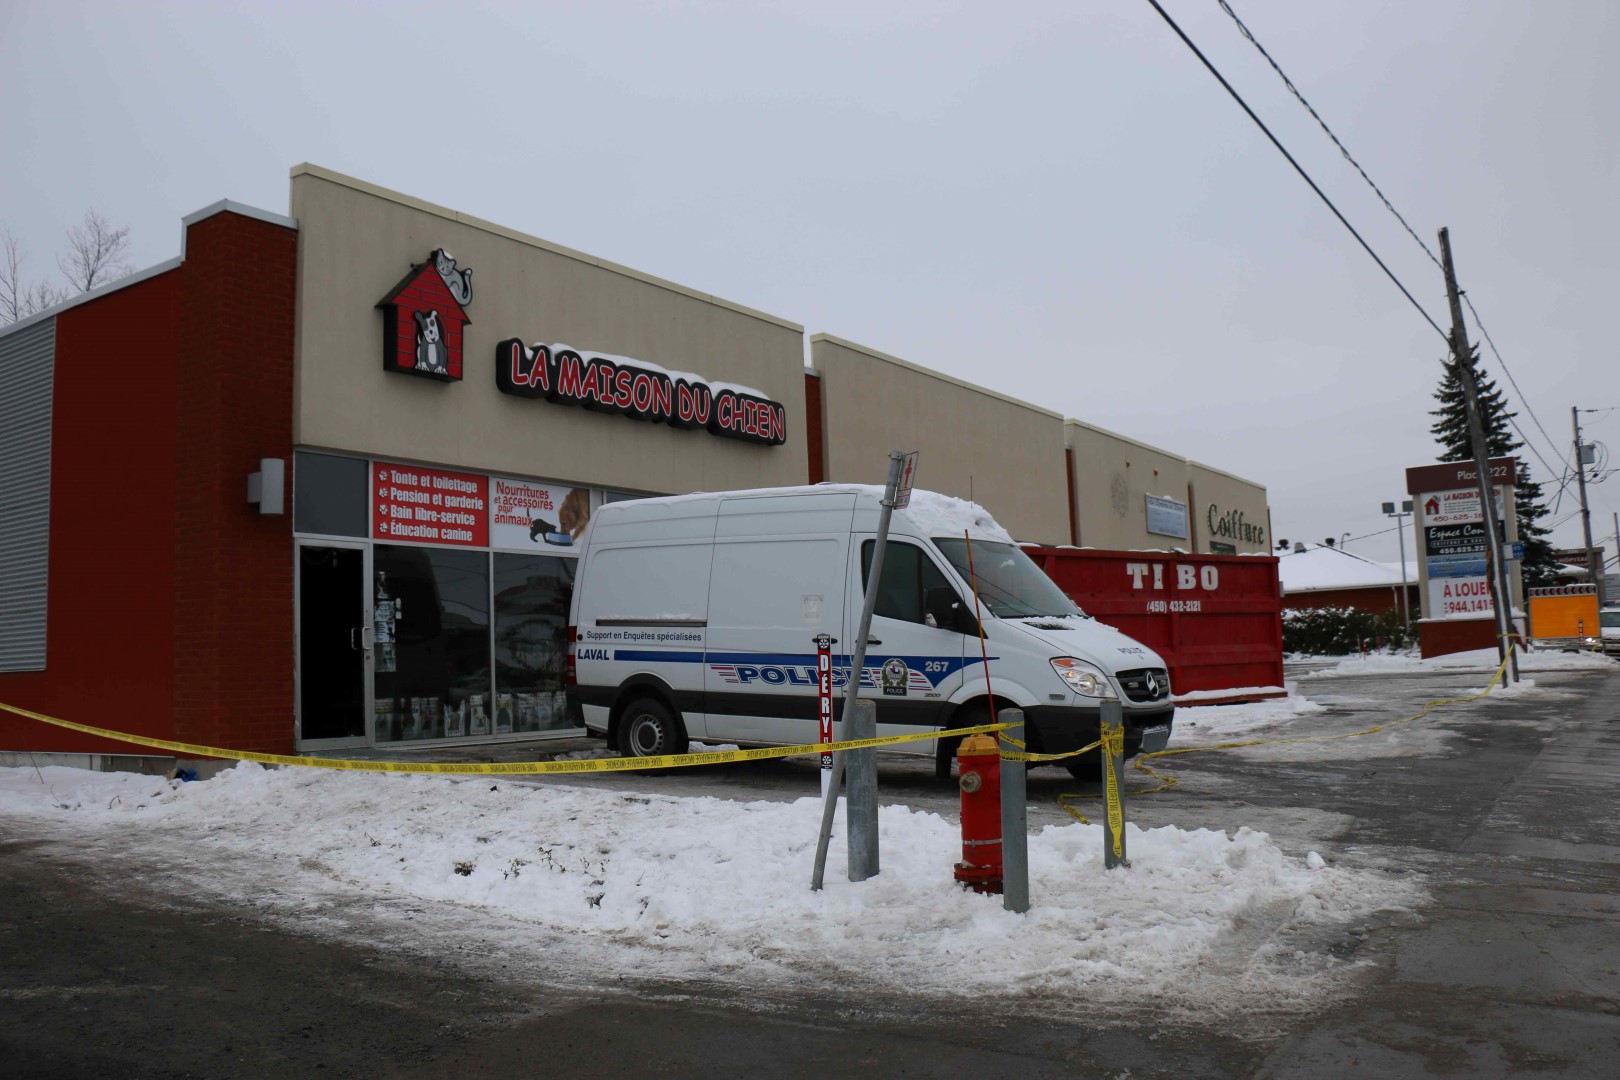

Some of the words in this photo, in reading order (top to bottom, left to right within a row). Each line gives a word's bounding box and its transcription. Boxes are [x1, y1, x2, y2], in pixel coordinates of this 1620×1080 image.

[511, 342, 549, 391] LA
[558, 355, 672, 417] MAISON
[678, 382, 711, 424] DU
[717, 395, 785, 441] CHIEN
[390, 470, 418, 486] Tonte
[420, 474, 430, 487] et
[433, 476, 478, 494] toilettage
[1457, 470, 1477, 481] Plac
[496, 481, 549, 500] Nourritures
[390, 487, 430, 504] Pension
[432, 493, 443, 506] et
[444, 495, 483, 510] garderie
[493, 496, 501, 504] et
[502, 495, 554, 510] accessoires
[390, 504, 412, 519] Bain
[415, 507, 476, 526] libre-service
[497, 504, 514, 513] pour
[494, 512, 533, 527] animaux
[1207, 503, 1264, 544] Coiffure
[390, 519, 439, 538] Éducation
[441, 528, 473, 541] canine
[1430, 527, 1460, 539] Espace
[1443, 581, 1452, 598] À
[1146, 600, 1167, 613] (450)
[1169, 600, 1201, 612] 432-2121
[586, 630, 612, 640] Support
[623, 631, 655, 641] Enquêtes
[656, 632, 702, 642] spécialisées
[577, 648, 610, 660] LAVAL
[924, 660, 950, 673] 267
